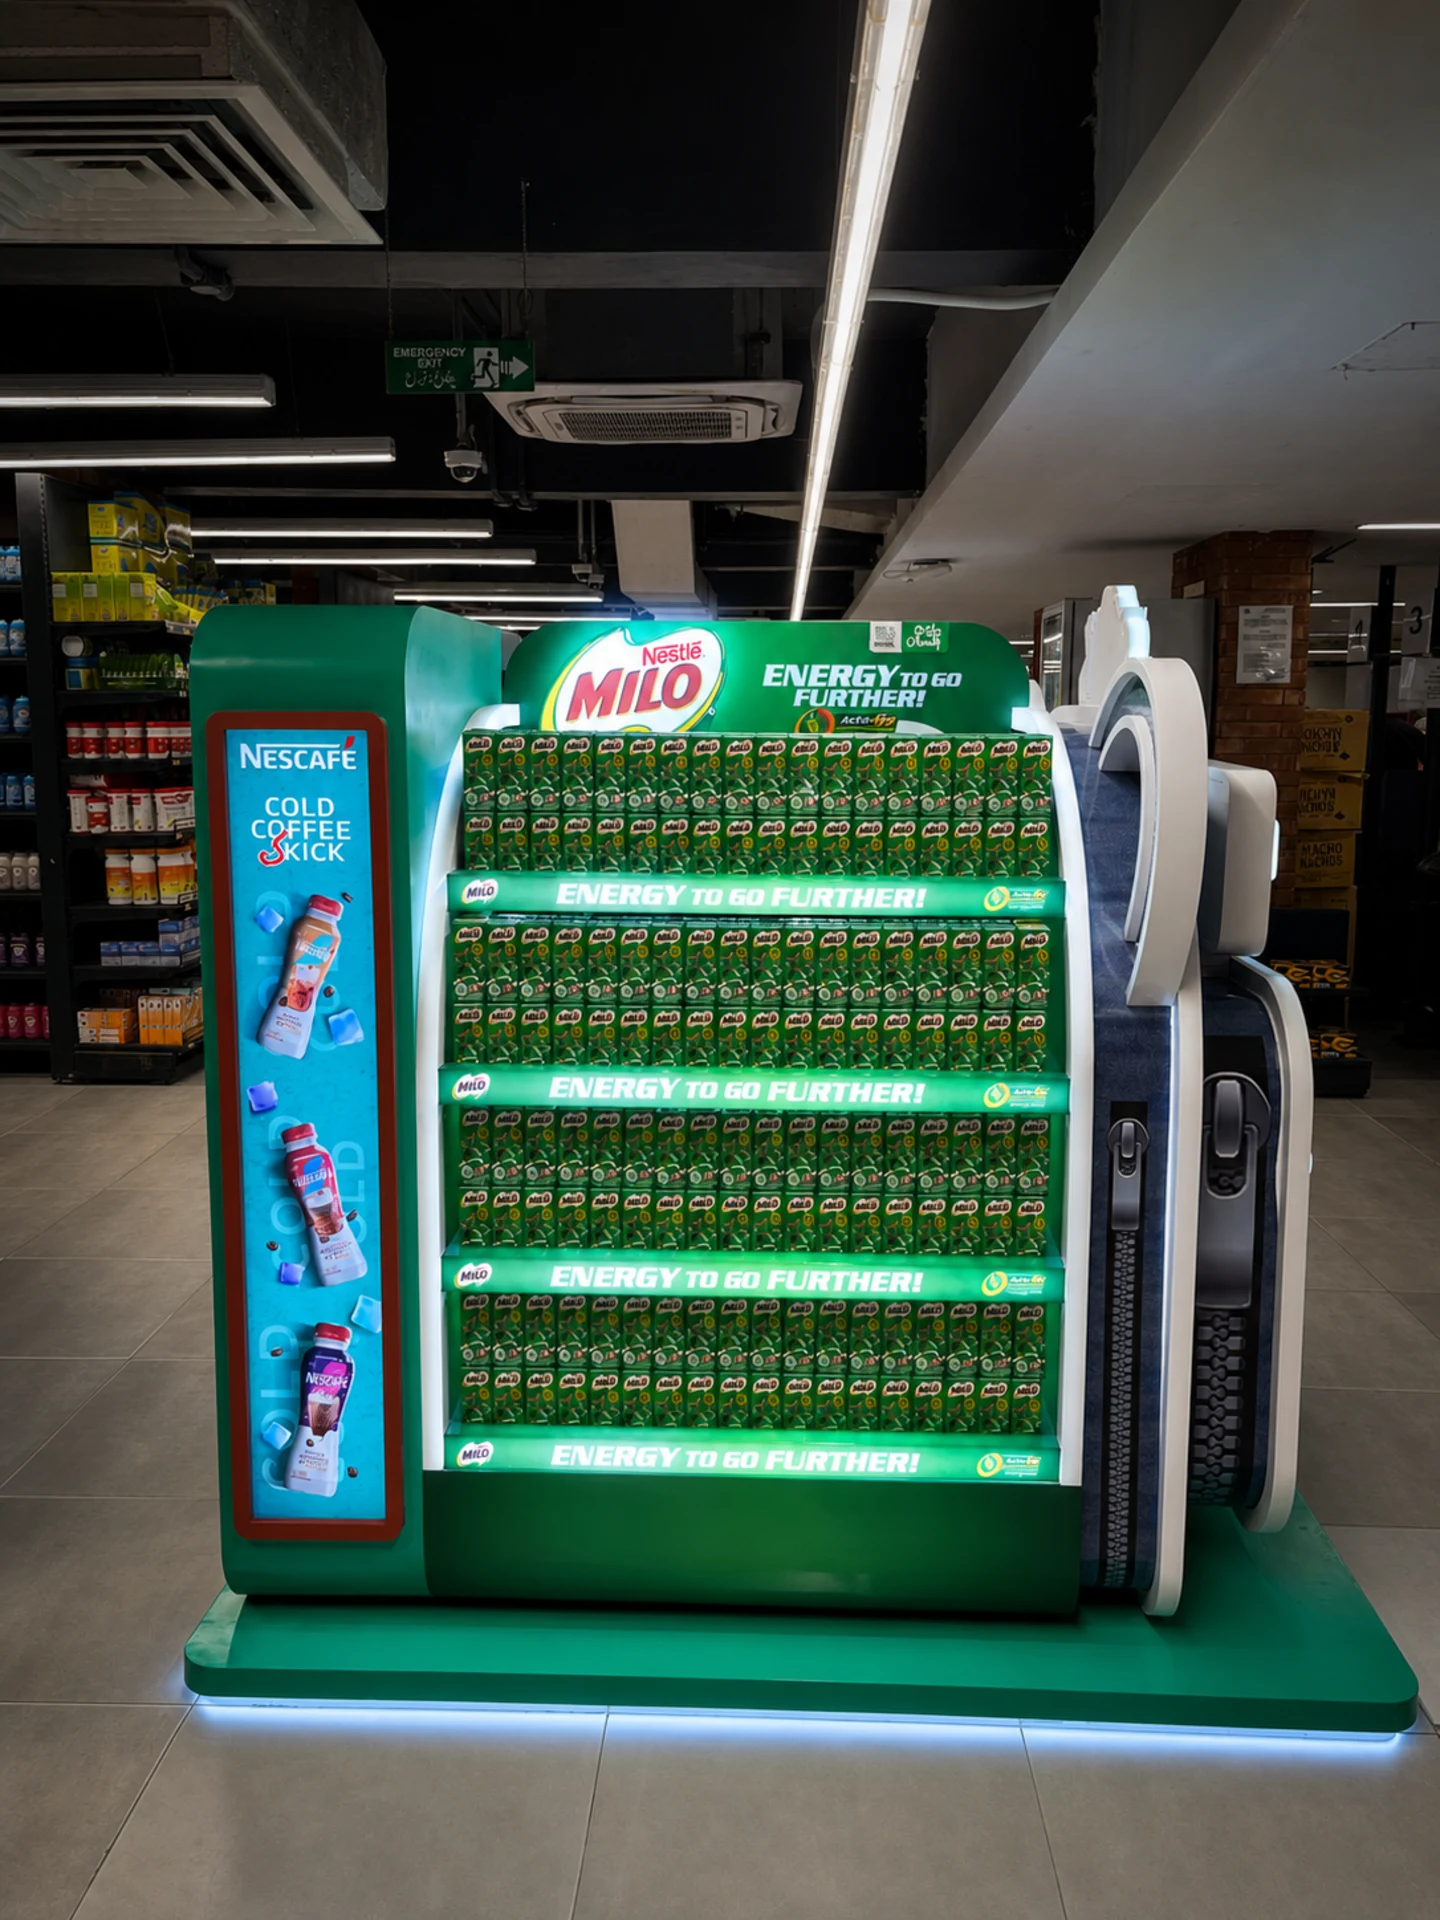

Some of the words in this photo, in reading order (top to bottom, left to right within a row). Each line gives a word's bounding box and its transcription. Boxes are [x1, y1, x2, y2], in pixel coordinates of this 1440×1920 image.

[393, 347, 466, 359] EMERGENCY
[1409, 606, 1423, 634] 3
[643, 640, 702, 666] Nestlé
[762, 664, 901, 687] ENERGY
[900, 673, 928, 687] TO
[931, 673, 962, 687] GO
[566, 662, 702, 723] MILO
[793, 689, 927, 708] FURTHER!
[240, 735, 358, 770] NESCAFÉ
[265, 797, 335, 817] COLD
[251, 819, 351, 840] COFFEE
[466, 885, 495, 899] MILO
[556, 883, 688, 906] ENERGY
[691, 888, 722, 905] TO
[728, 889, 764, 907] GO
[771, 887, 927, 908] FURTHER!
[457, 1079, 486, 1093] MILO
[549, 1077, 682, 1100] ENERGY
[685, 1081, 718, 1099] TO
[724, 1081, 761, 1100] GO
[767, 1081, 925, 1103] FURTHER!
[460, 1269, 488, 1282] MILO
[550, 1266, 682, 1288] ENERGY
[685, 1271, 718, 1288] TO
[724, 1271, 760, 1289] GO
[767, 1270, 924, 1293] FURTHER!
[462, 1447, 490, 1460] MILO
[551, 1445, 682, 1467] ENERGY
[685, 1450, 718, 1468] TO
[723, 1451, 759, 1469] GO
[764, 1450, 920, 1473] FURTHER!
